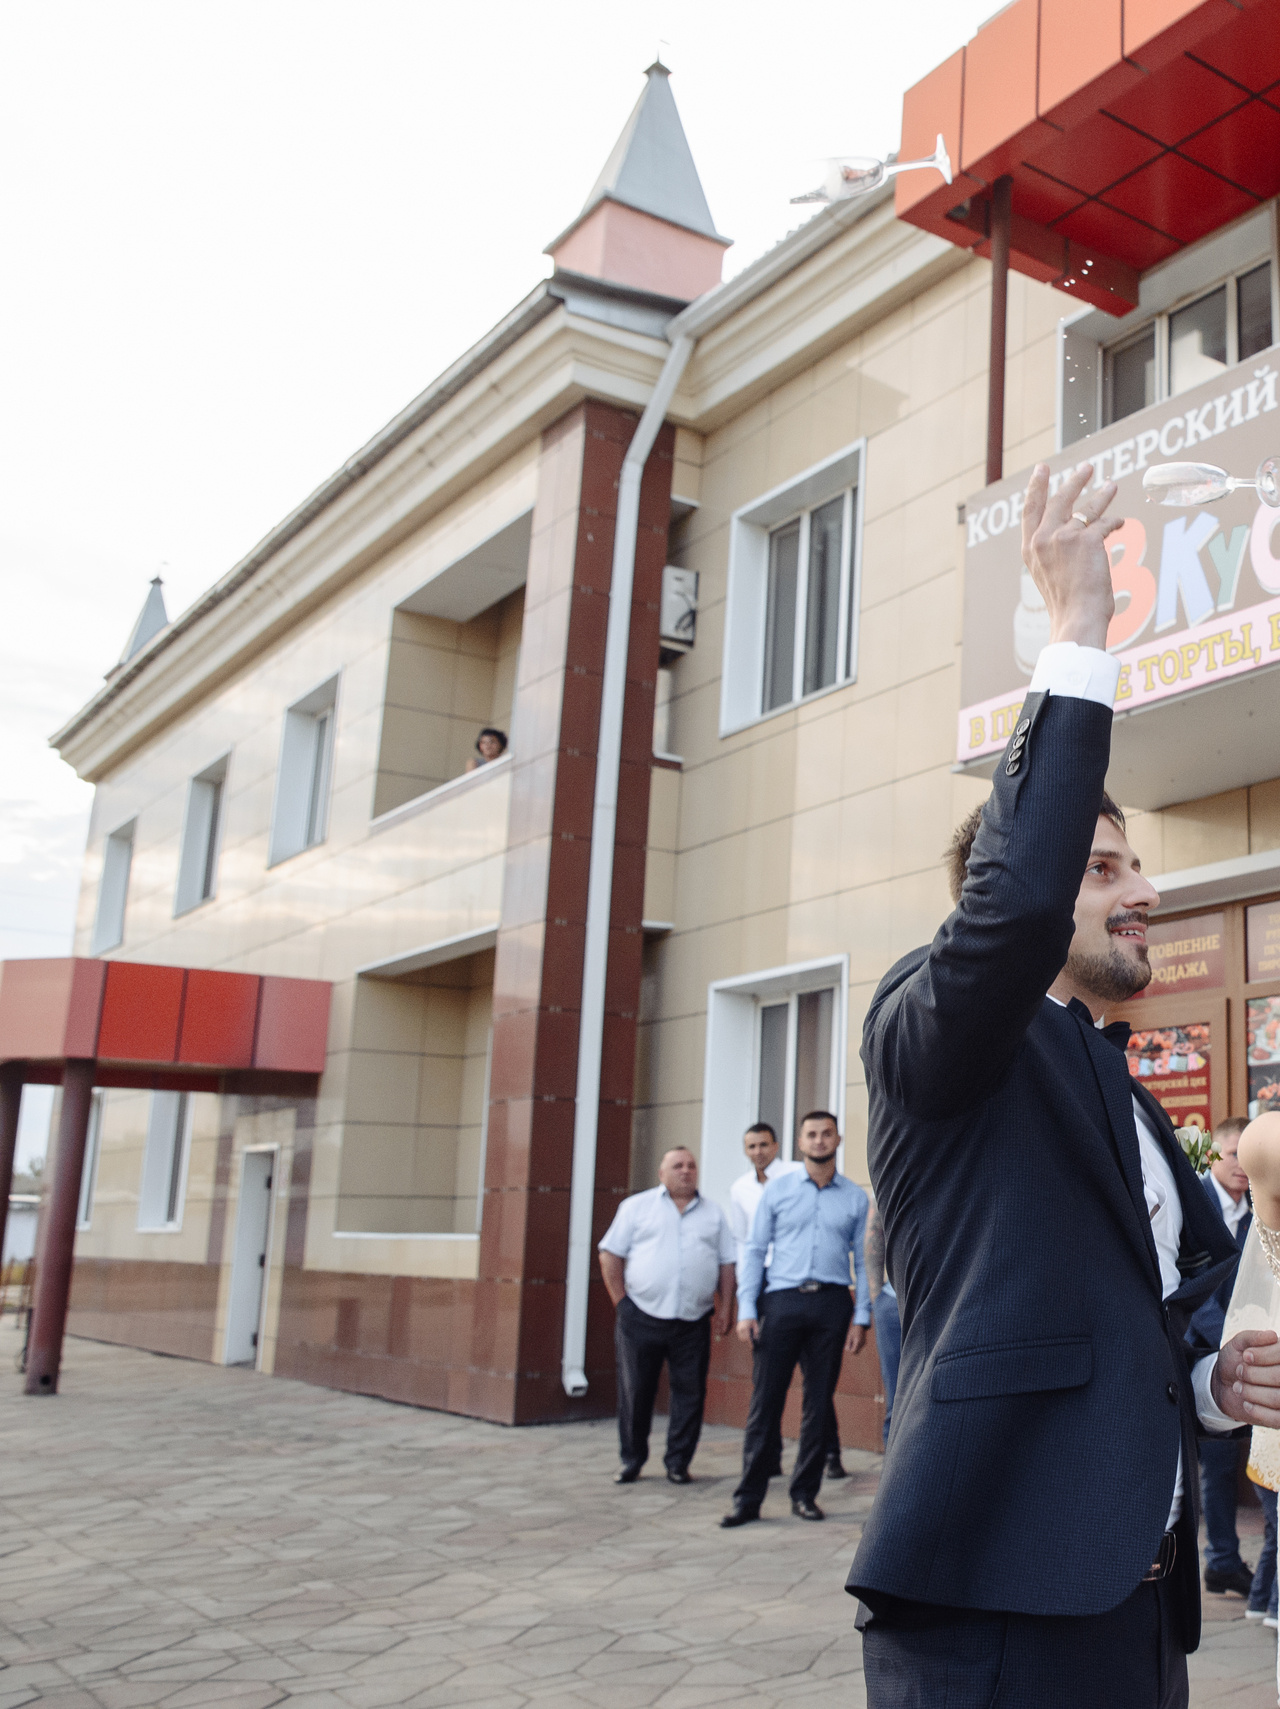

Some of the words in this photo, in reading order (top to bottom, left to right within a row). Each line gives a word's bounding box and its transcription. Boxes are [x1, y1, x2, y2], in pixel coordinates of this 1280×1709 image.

[966, 364, 1279, 548] КОНТЕРСКИЙ
[968, 715, 986, 749] В
[1138, 622, 1262, 694] ТОРТЫ,
[1148, 934, 1220, 960] ТОВЛЕНИЕ
[1150, 961, 1209, 984] РОДАЖА
